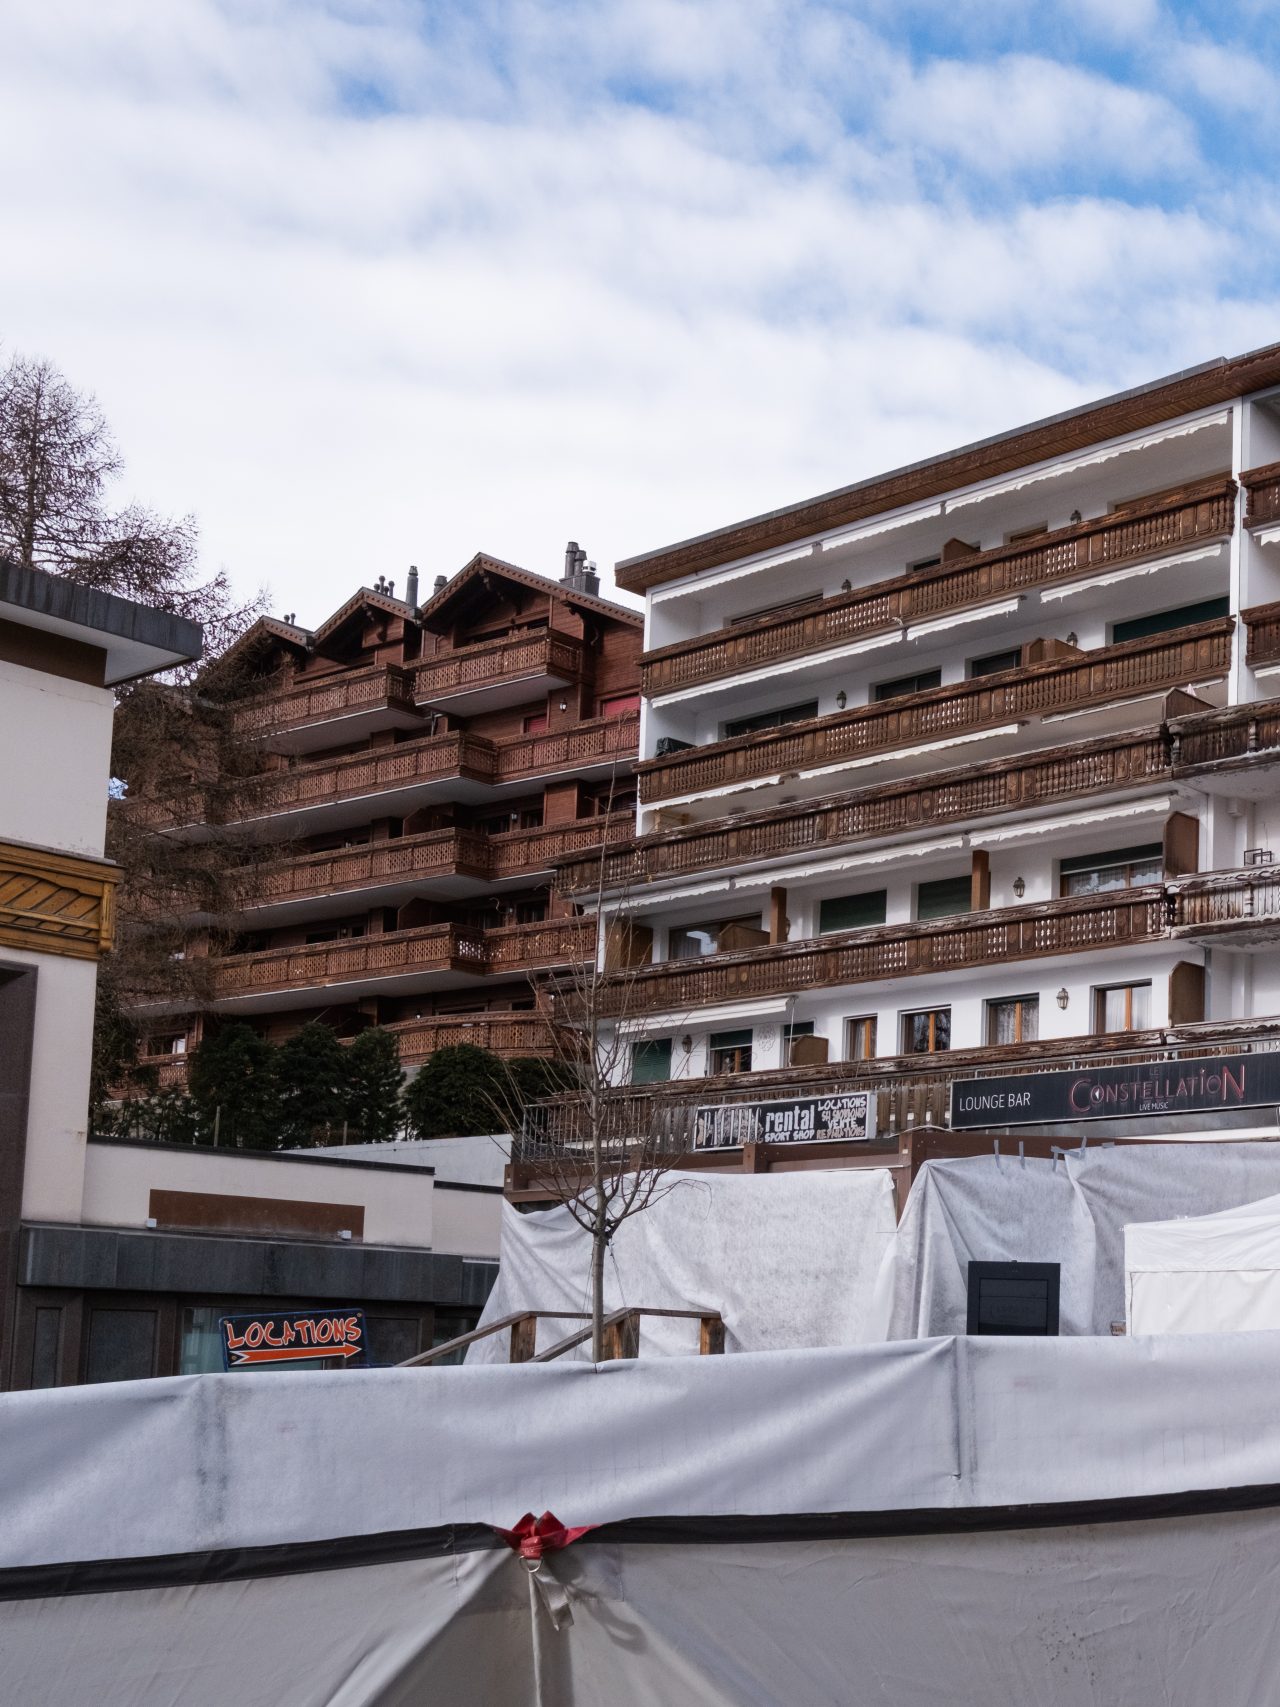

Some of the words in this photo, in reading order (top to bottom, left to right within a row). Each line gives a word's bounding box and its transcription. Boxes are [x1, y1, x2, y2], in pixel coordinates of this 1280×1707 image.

[818, 1096, 867, 1111] LOCATIONS
[960, 1094, 1006, 1112] LOUNGE
[1008, 1092, 1031, 1108] BAR
[1139, 1103, 1151, 1111] LIVE
[1152, 1102, 1169, 1110] MUSIC
[765, 1104, 815, 1132] rental
[828, 1118, 858, 1130] VENTE
[764, 1131, 791, 1143] SPORT
[793, 1129, 815, 1140] SHOP
[227, 1317, 362, 1349] LOCATIONS
